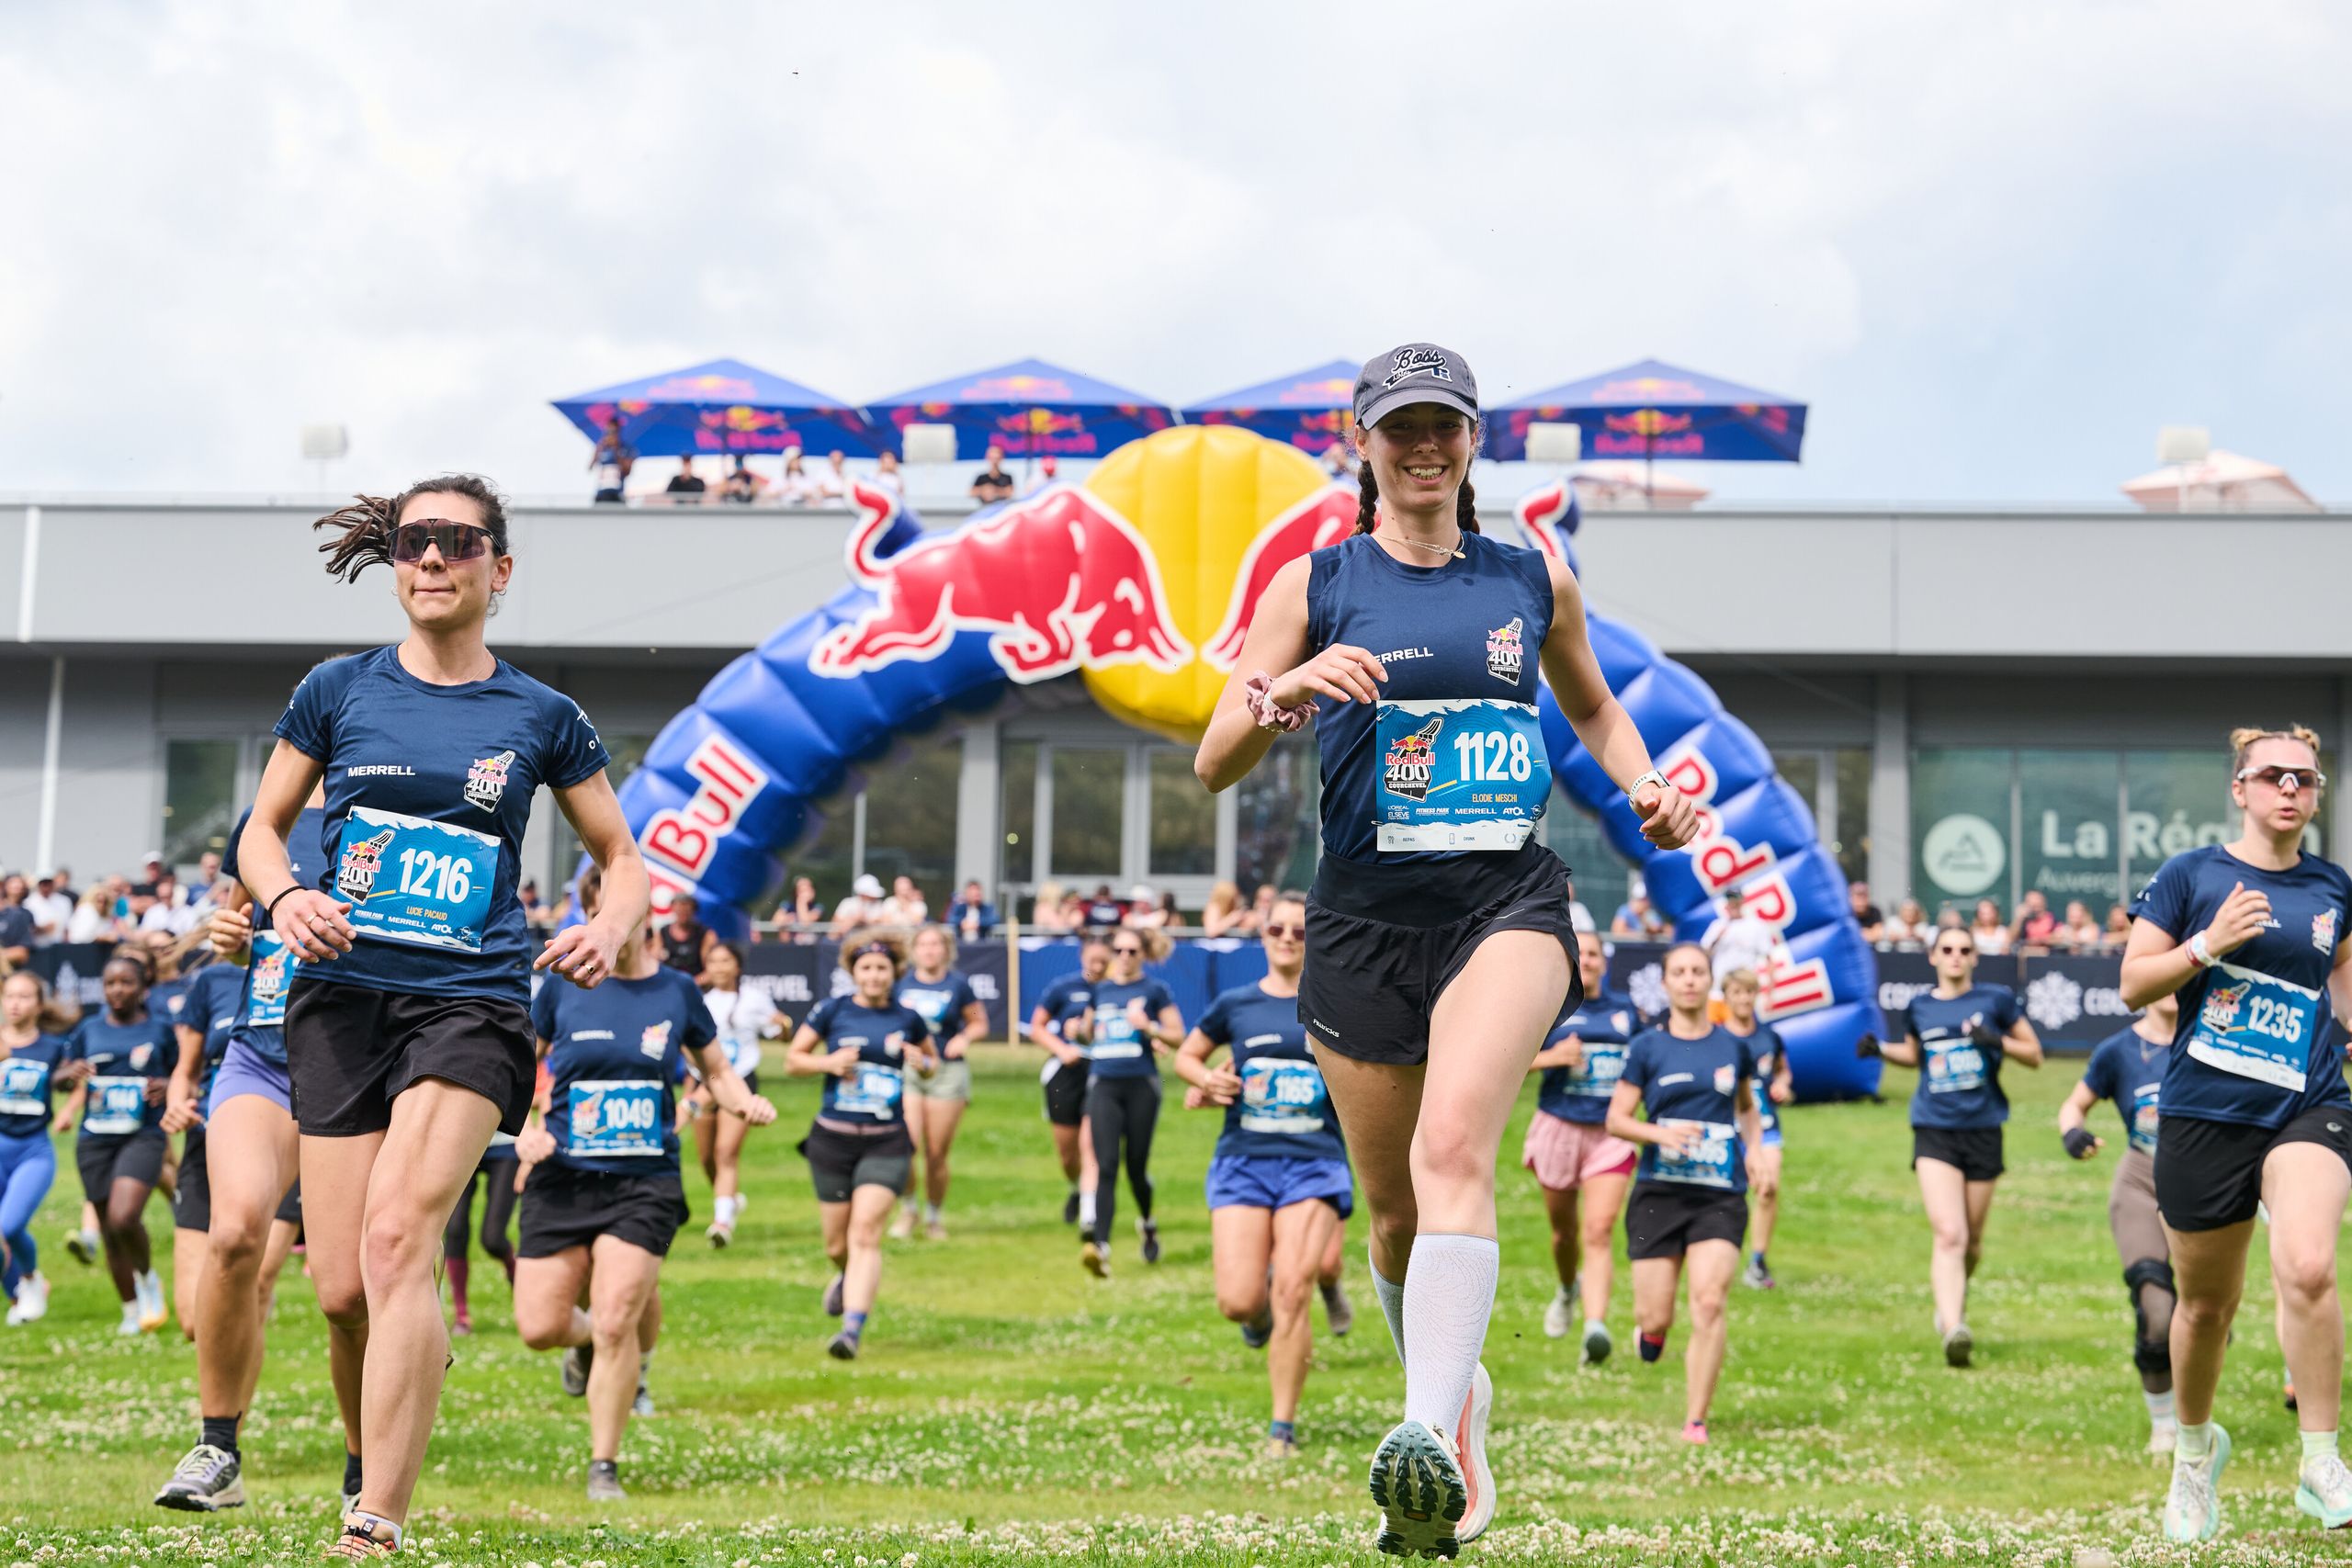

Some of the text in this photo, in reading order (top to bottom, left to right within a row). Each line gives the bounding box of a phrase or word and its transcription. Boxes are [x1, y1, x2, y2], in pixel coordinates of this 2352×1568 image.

[1392, 348, 1444, 372] Boss
[1374, 647, 1433, 664] ERRELL
[1488, 651, 1521, 667] 400
[1386, 753, 1434, 765] Red Bull
[1453, 731, 1532, 782] 1128
[348, 765, 415, 777] MERRELL
[469, 769, 506, 784] Red Bull
[1385, 765, 1430, 781] 400
[467, 779, 501, 795] 400
[649, 743, 755, 870] Bull
[1472, 794, 1518, 803] ELODIE MESCHI
[1503, 807, 1525, 816] ATOL
[2041, 809, 2109, 859] La
[342, 855, 380, 872] Red Bull
[340, 866, 372, 886] 400
[400, 848, 472, 904] 1216
[406, 906, 447, 921] LUCIE PACAUD
[388, 916, 426, 929] MERRELL
[431, 923, 453, 934] ATOL
[2248, 995, 2304, 1043] 1235
[604, 1097, 656, 1130] 1049
